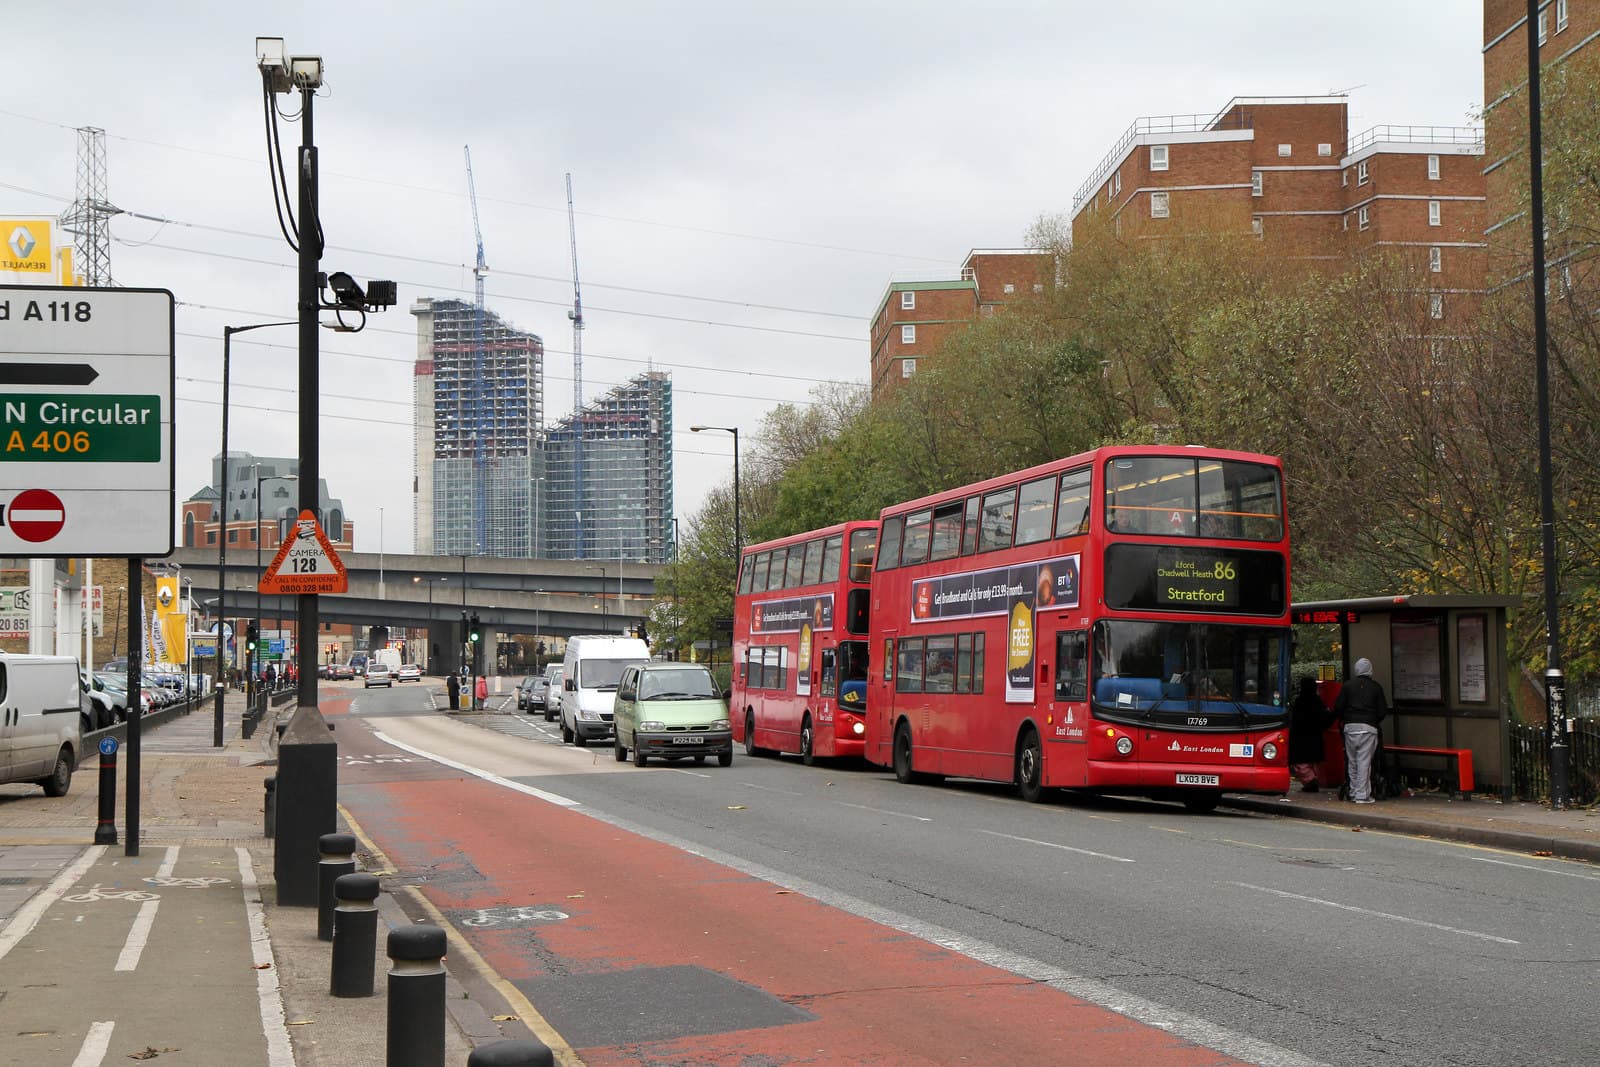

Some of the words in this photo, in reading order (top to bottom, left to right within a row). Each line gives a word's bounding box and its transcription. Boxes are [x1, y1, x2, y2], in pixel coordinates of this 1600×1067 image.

[23, 301, 92, 322] A118
[5, 402, 26, 424] N
[39, 402, 151, 425] Circular
[289, 549, 326, 557] CAMERA
[292, 558, 317, 573] 128
[1157, 569, 1190, 577] Chadwell
[1192, 570, 1213, 578] Heath
[1214, 561, 1235, 579] 86
[1175, 561, 1195, 569] Ilford
[1057, 576, 1066, 586] BT
[1168, 587, 1225, 602] Stratford
[1012, 628, 1030, 647] FREE
[1056, 726, 1066, 736] East
[1066, 726, 1083, 737] London
[1179, 775, 1200, 784] LX03
[1201, 776, 1217, 784] BVE
